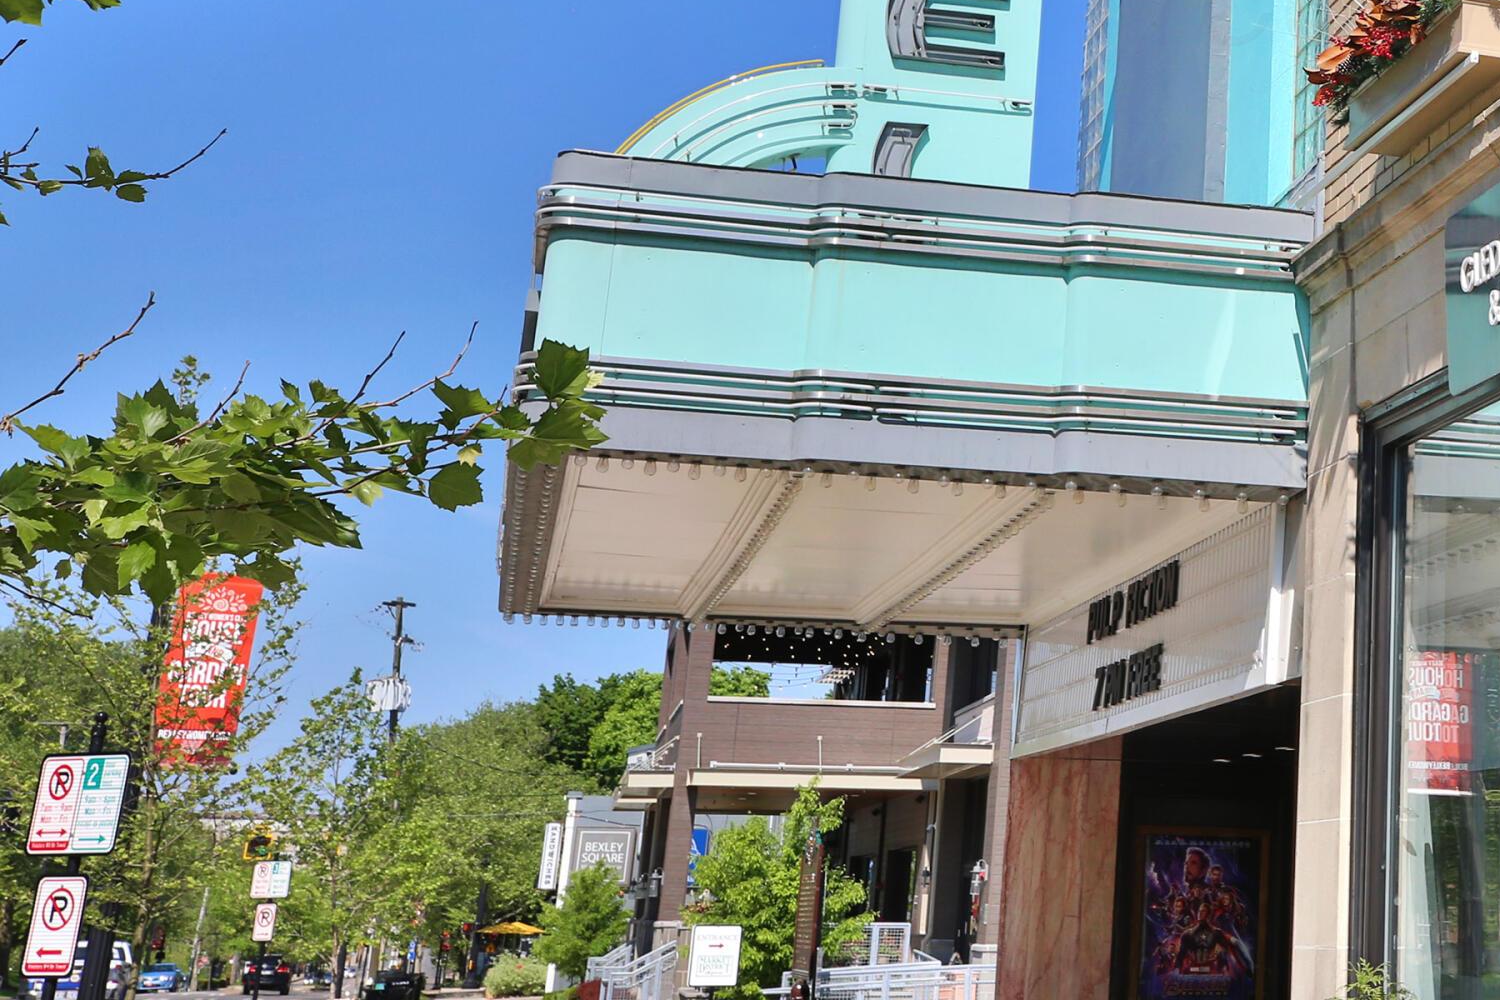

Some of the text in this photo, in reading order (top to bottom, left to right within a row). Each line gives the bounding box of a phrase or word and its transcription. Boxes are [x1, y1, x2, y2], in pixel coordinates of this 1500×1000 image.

[1087, 559, 1180, 645] PULP FICTION
[1126, 642, 1164, 700] FREE
[87, 762, 100, 787] 2
[581, 852, 625, 864] SQUARE
[585, 841, 625, 852] BEXLEY
